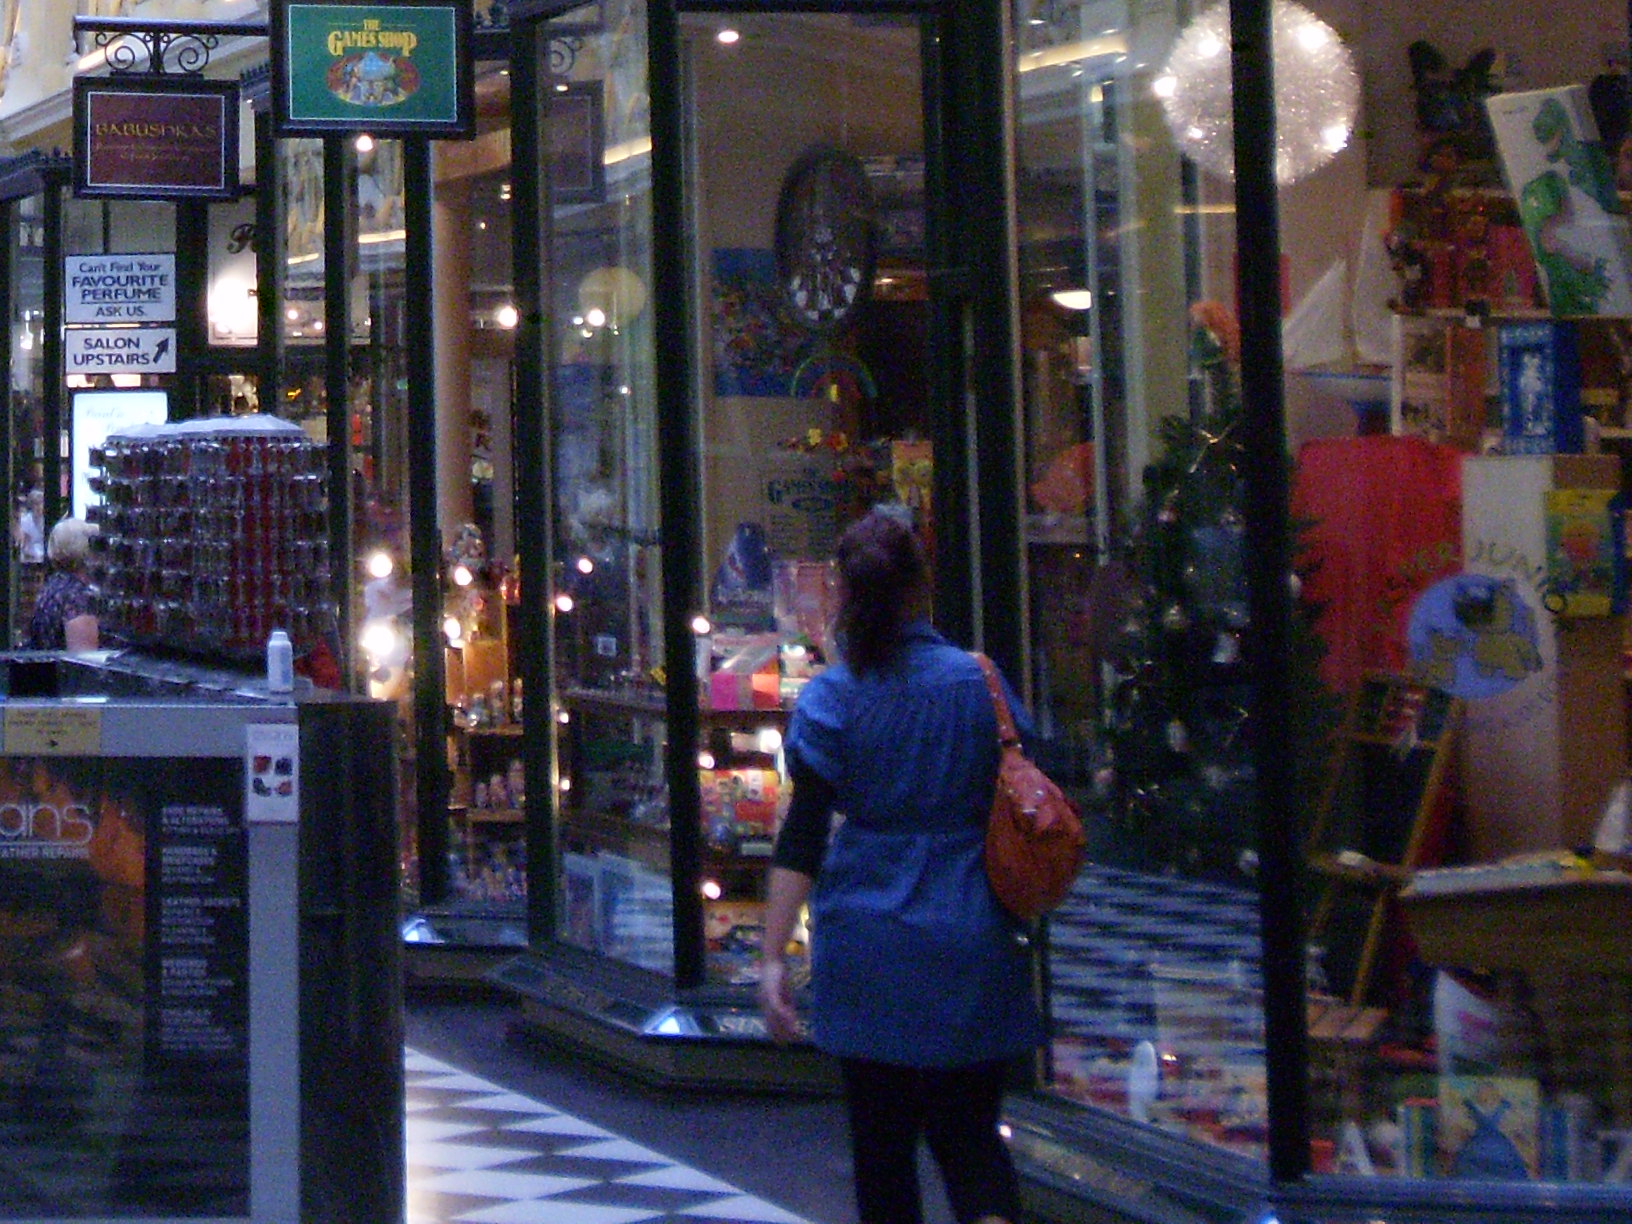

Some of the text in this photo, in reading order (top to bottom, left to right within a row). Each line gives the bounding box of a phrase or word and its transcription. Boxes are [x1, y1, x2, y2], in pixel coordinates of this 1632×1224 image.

[363, 19, 381, 30] THE
[328, 31, 417, 57] GAMES SHOP
[110, 261, 134, 272] Find
[137, 261, 161, 272] Your
[72, 274, 169, 287] FAVOURITE
[81, 287, 162, 300] PERFUME
[96, 305, 122, 317] ASK
[84, 337, 140, 350] SALON
[73, 352, 151, 366] UPSTAIRS
